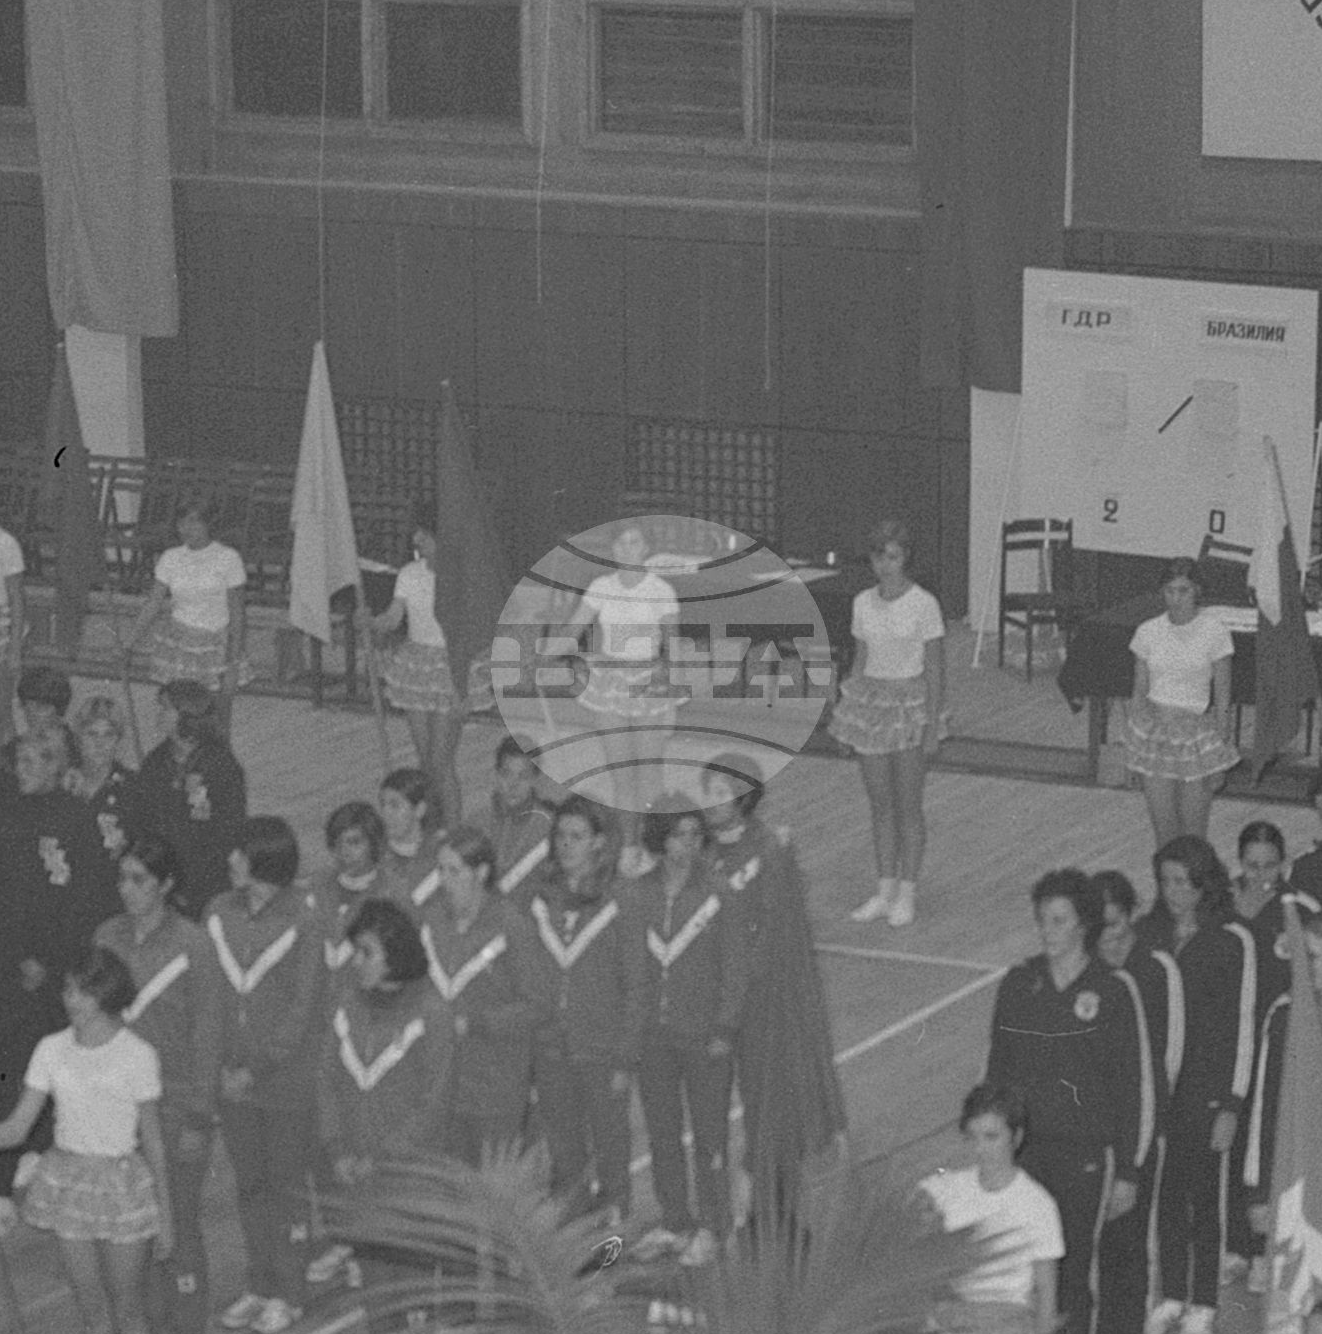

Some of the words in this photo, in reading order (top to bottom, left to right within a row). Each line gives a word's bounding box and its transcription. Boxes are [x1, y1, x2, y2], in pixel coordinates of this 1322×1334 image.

[1060, 308, 1112, 329] ГДР
[1206, 320, 1286, 343] БРАЗИЛИЯ
[1102, 498, 1119, 524] 2
